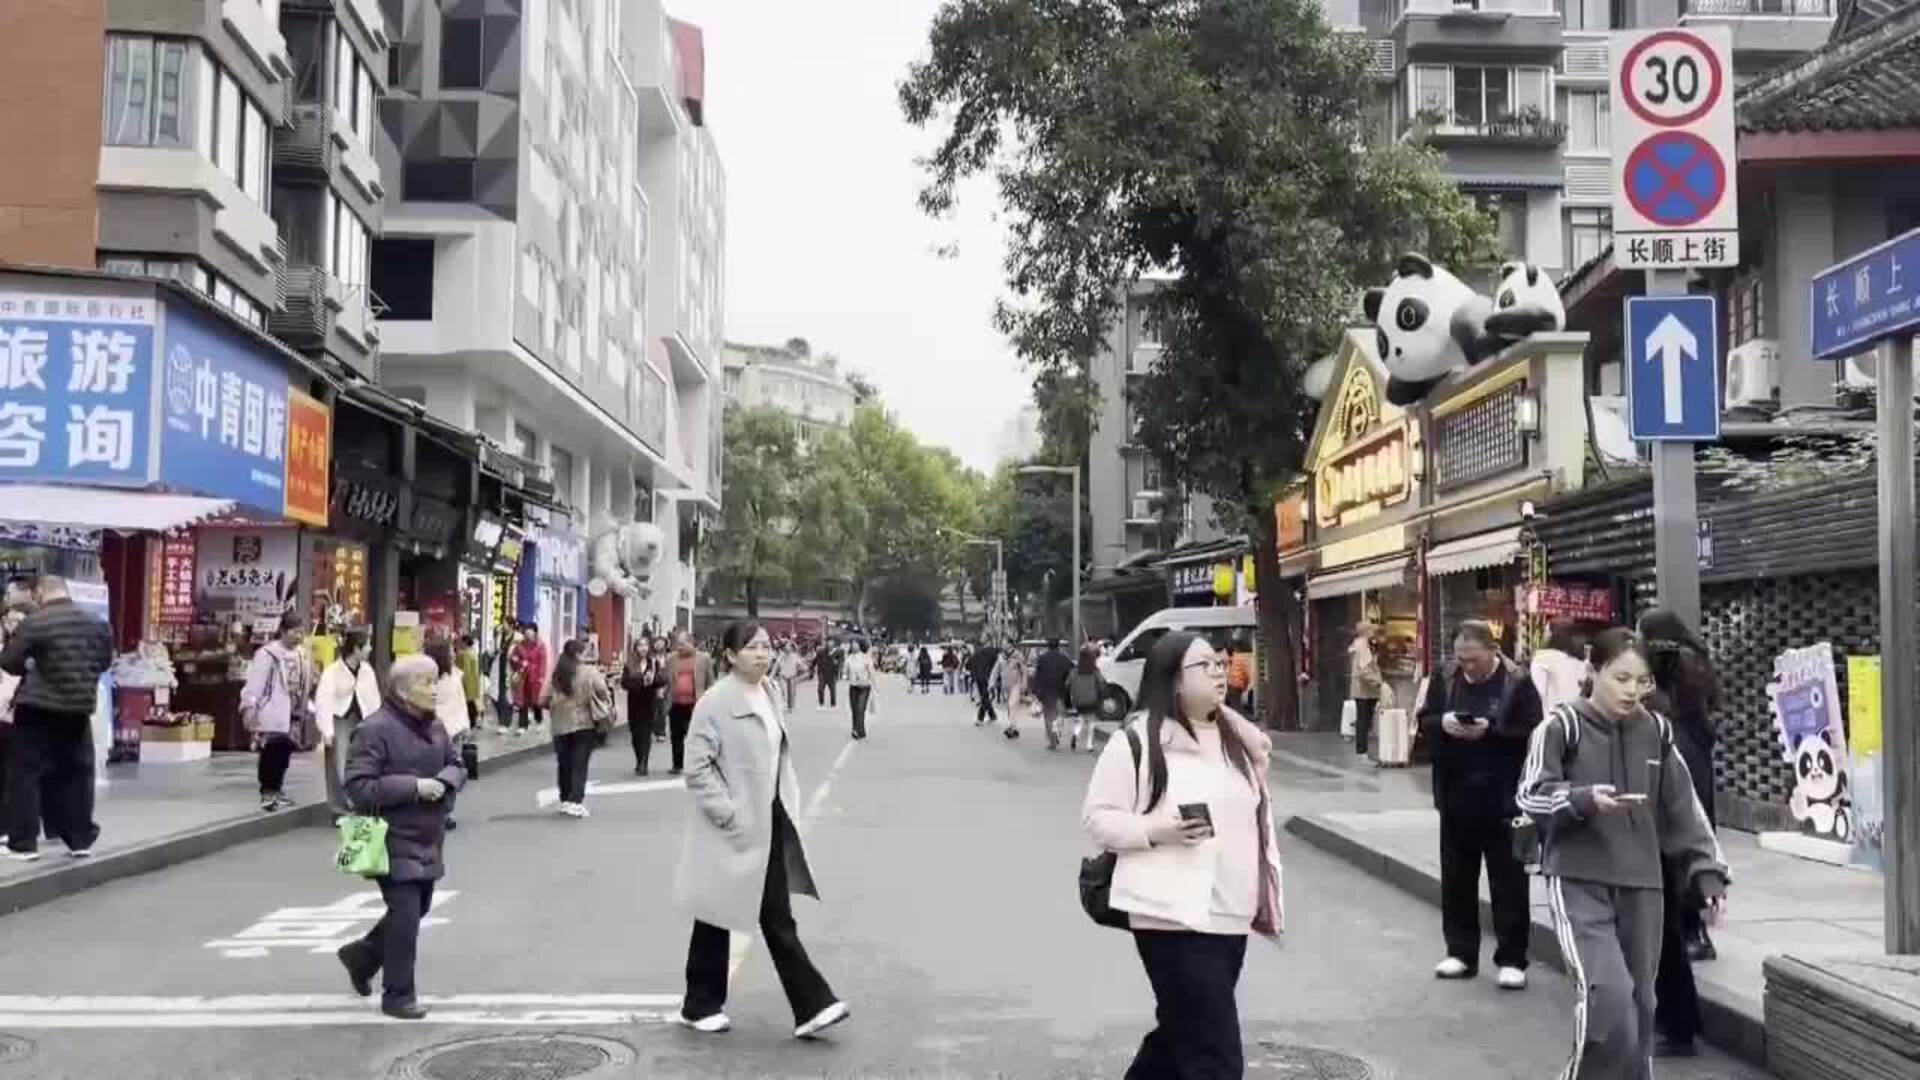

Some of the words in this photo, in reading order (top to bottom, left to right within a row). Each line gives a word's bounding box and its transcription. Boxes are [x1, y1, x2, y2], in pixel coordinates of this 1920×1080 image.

[1644, 54, 1699, 104] 30
[1627, 237, 1727, 263] 长顺上街
[1825, 254, 1903, 319] 长顺上
[0, 326, 137, 394] 旅游
[0, 402, 134, 472] 咨询
[194, 358, 285, 463] 中青国旅
